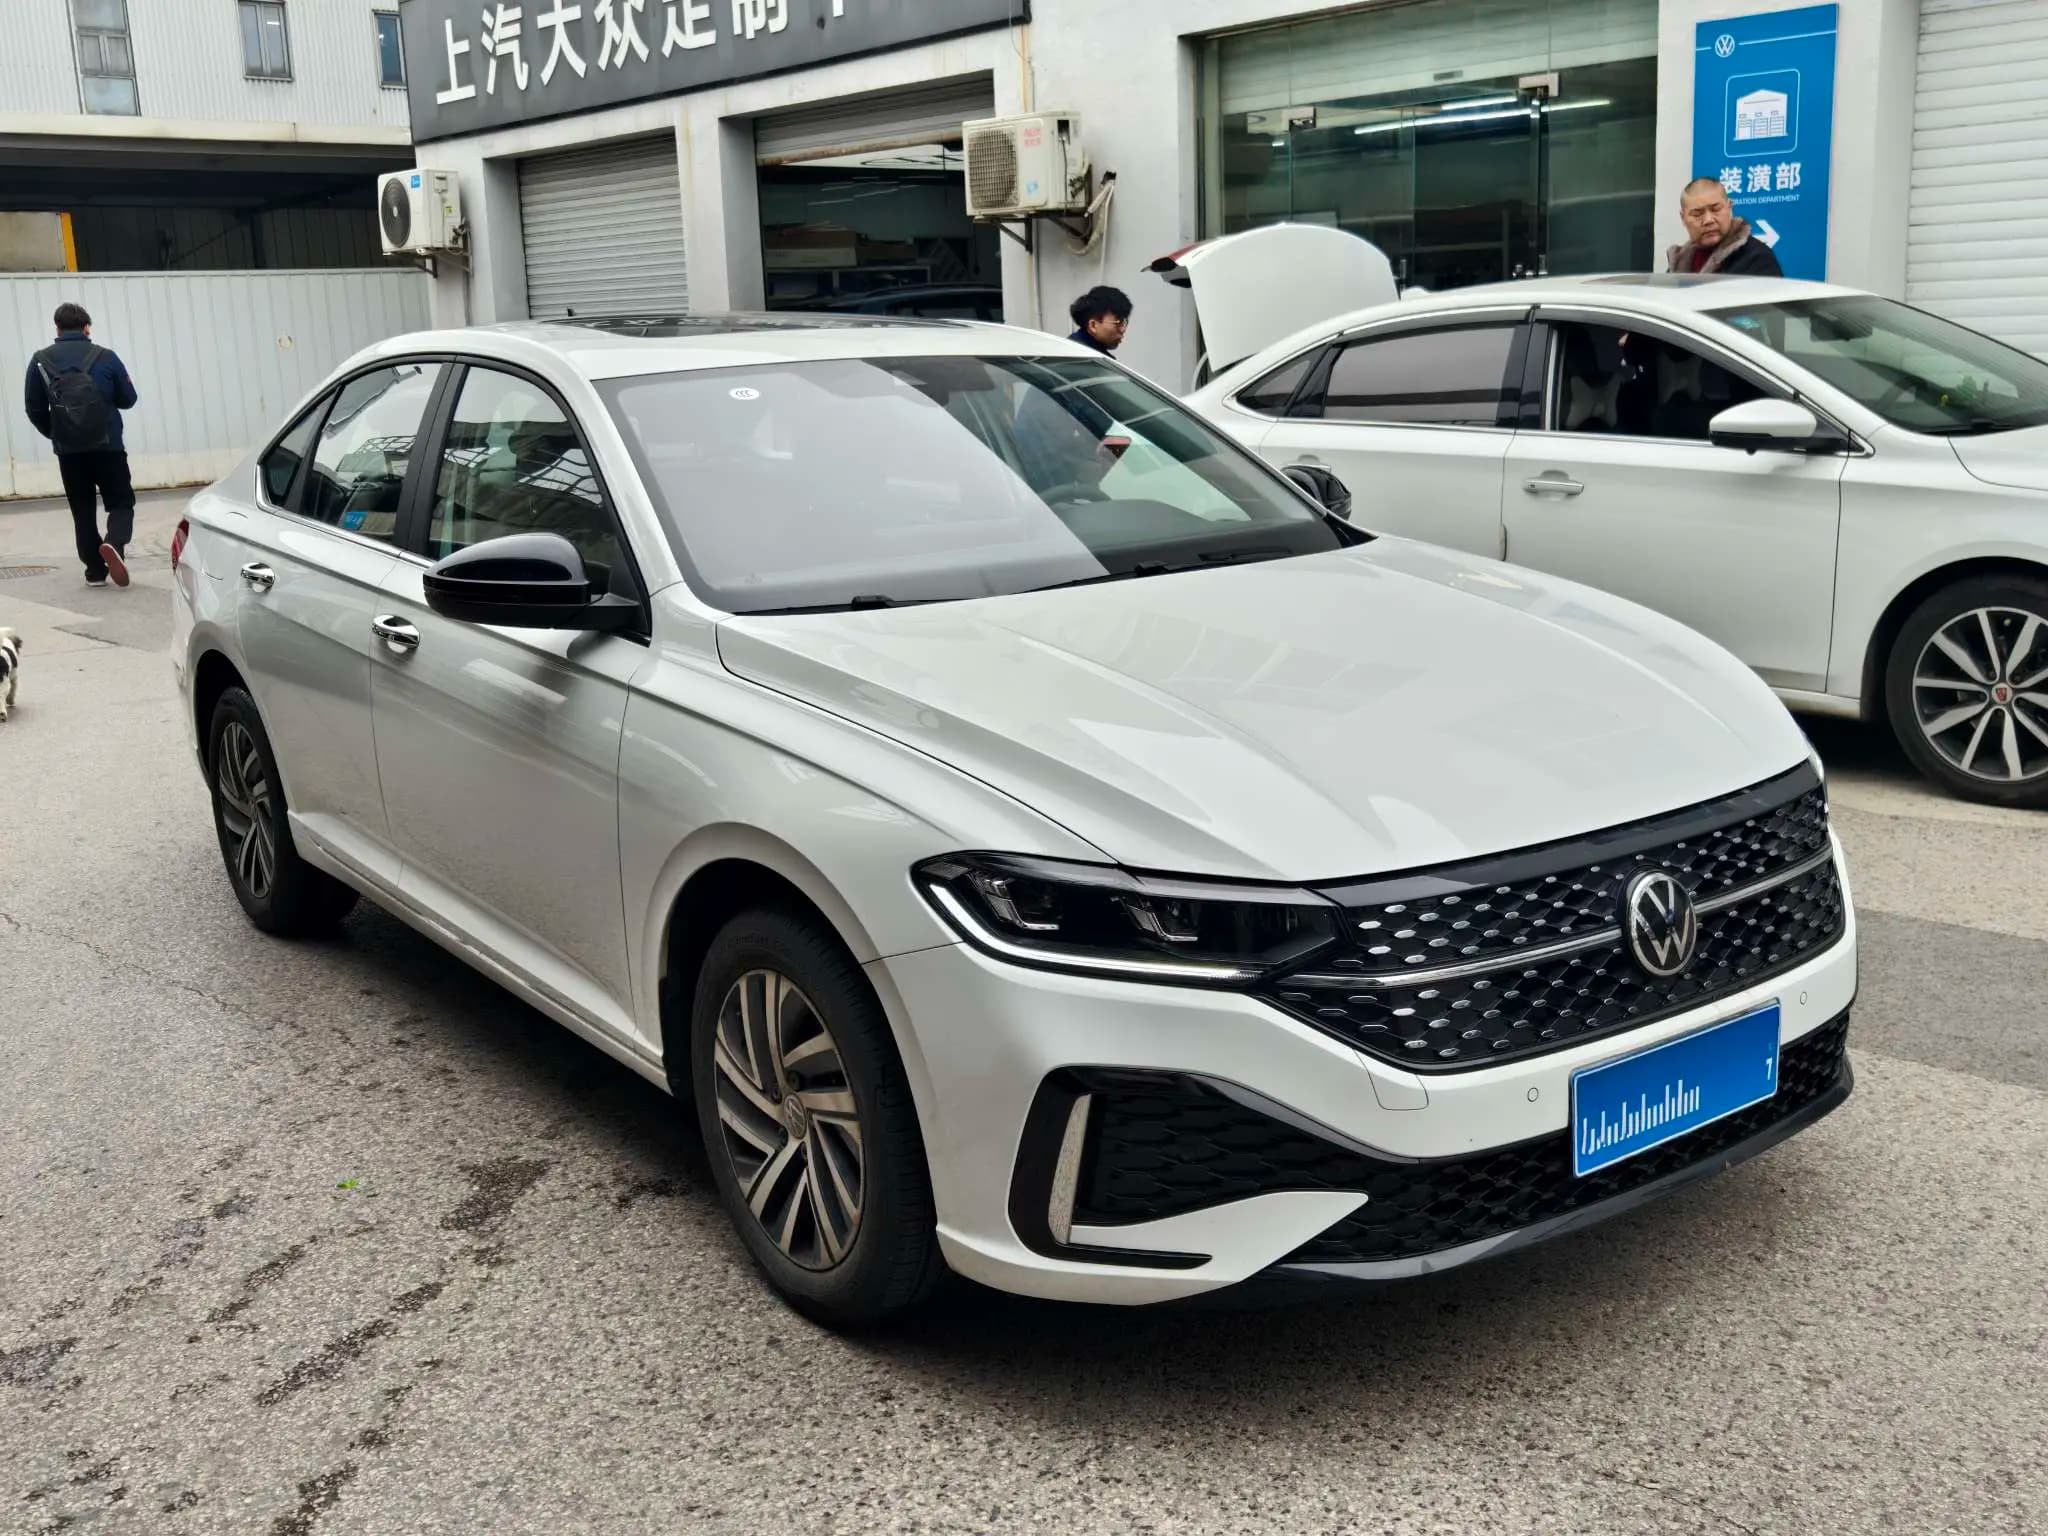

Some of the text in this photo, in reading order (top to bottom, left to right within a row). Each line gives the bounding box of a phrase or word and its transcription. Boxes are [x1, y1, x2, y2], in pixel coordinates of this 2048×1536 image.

[436, 0, 844, 105] 上汽大众定
[1720, 162, 1801, 194] 装潢部
